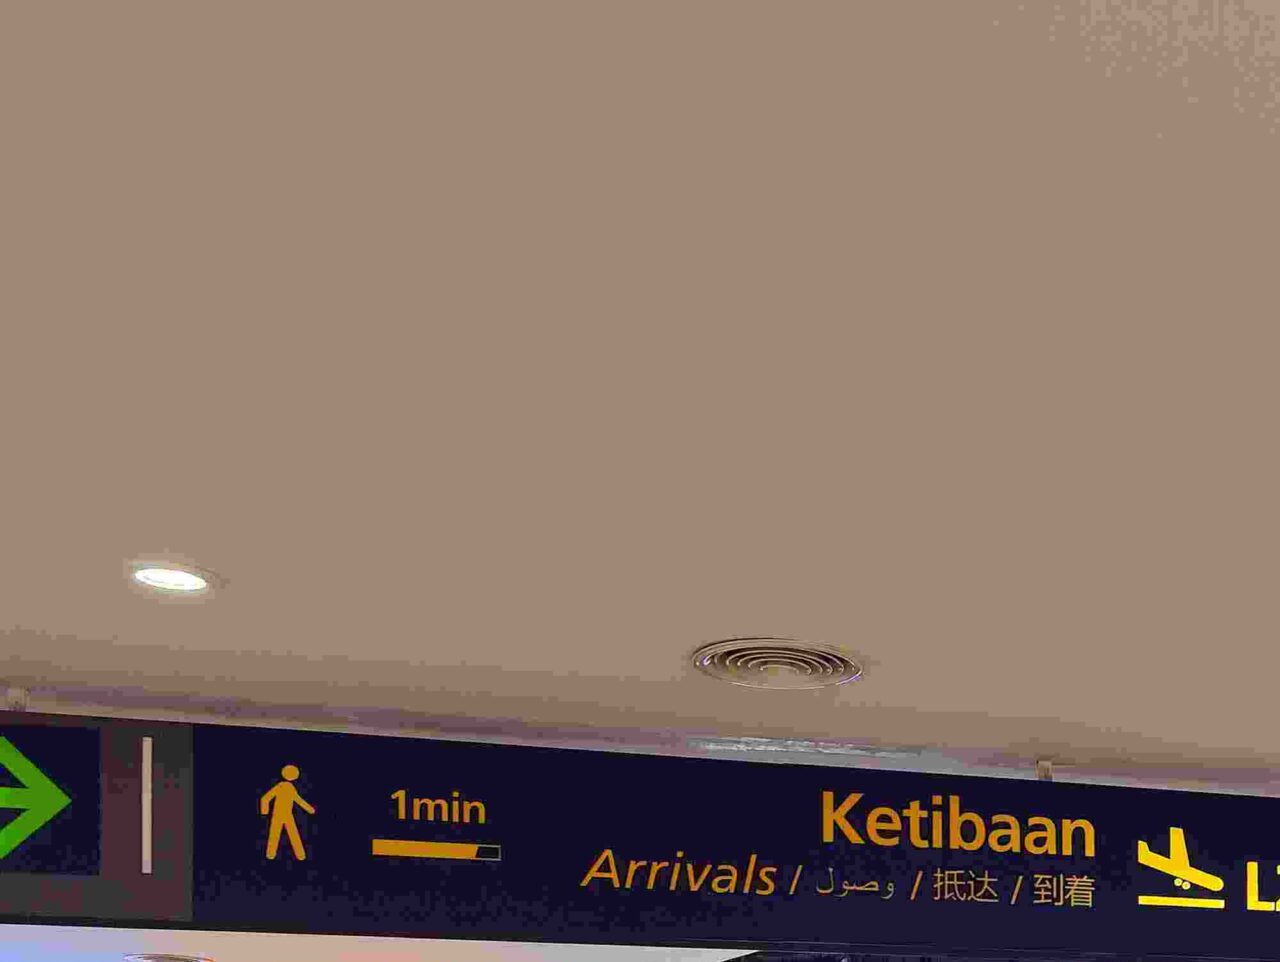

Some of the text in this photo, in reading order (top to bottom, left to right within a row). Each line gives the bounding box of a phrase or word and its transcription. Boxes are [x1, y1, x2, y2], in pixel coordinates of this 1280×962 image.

[390, 789, 487, 824] 1min
[821, 790, 1096, 857] Ketibaan
[580, 848, 778, 895] Arrivals
[932, 868, 1000, 905] 抵达
[1032, 872, 1096, 908] 到着
